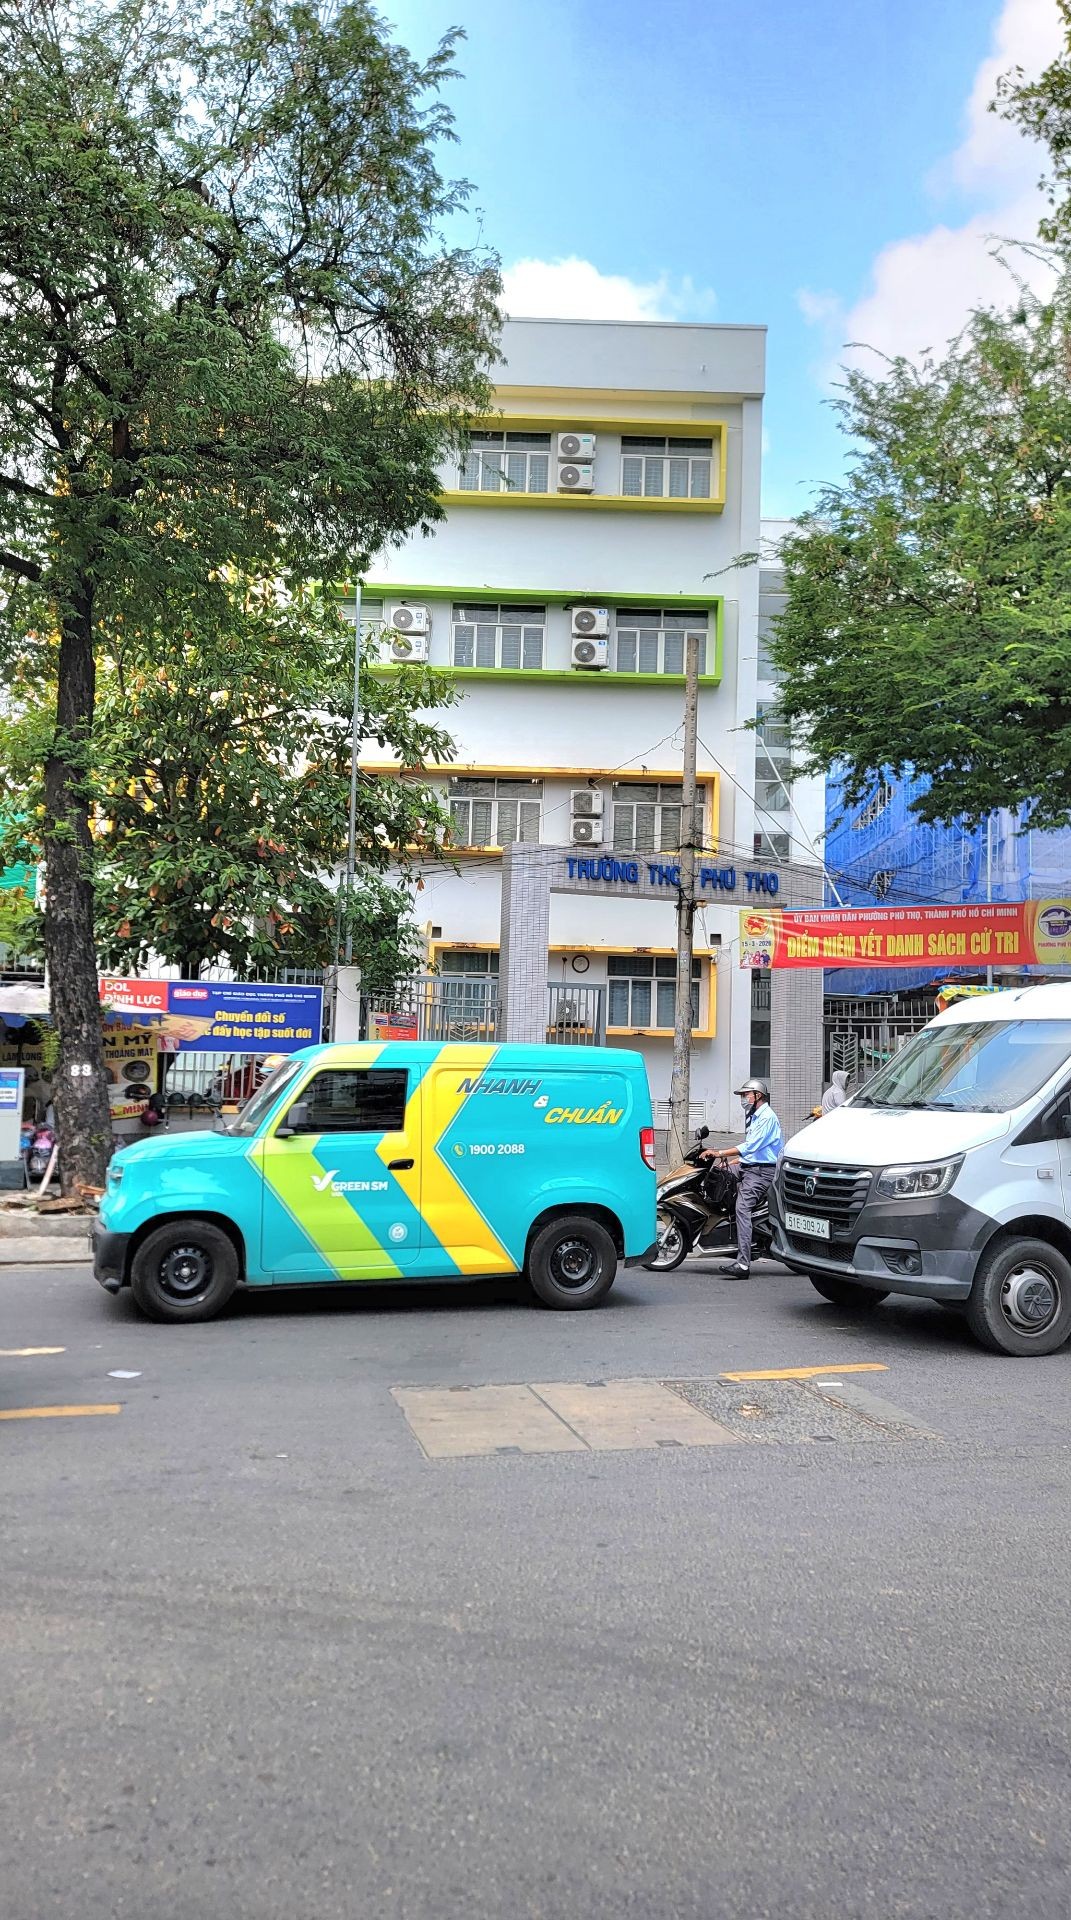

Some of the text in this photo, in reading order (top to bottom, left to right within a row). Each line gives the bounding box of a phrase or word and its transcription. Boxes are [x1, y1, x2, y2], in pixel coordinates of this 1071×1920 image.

[700, 866, 736, 890] PHÚ
[745, 871, 778, 896] THỌ
[805, 914, 819, 922] BAN
[821, 913, 840, 922] NHÂN
[842, 912, 857, 922] DÂN
[859, 911, 888, 921] PHƯỜNG
[889, 910, 904, 920] PHÚ
[925, 909, 949, 919] THÀNH
[951, 907, 967, 918] PHỐ
[969, 907, 979, 917] HỒ
[981, 906, 994, 917] CHÍ
[997, 907, 1018, 917] MINH
[787, 926, 1019, 958] ĐIỂM NIÊM YẾT DANH SÁCH CỬ TRI
[137, 994, 162, 1006] LỰC
[215, 1010, 286, 1023] Chuyển đổi số
[213, 1024, 232, 1037] đẩy
[233, 1026, 252, 1039] học
[254, 1027, 270, 1039] tập
[272, 1027, 294, 1038] suốt
[295, 1028, 312, 1039] đời
[456, 1078, 543, 1095] NHANH
[533, 1095, 549, 1108] &
[544, 1100, 624, 1124] CHUẨN
[469, 1144, 525, 1155] 1900 2088
[331, 1181, 389, 1191] GREEN SM
